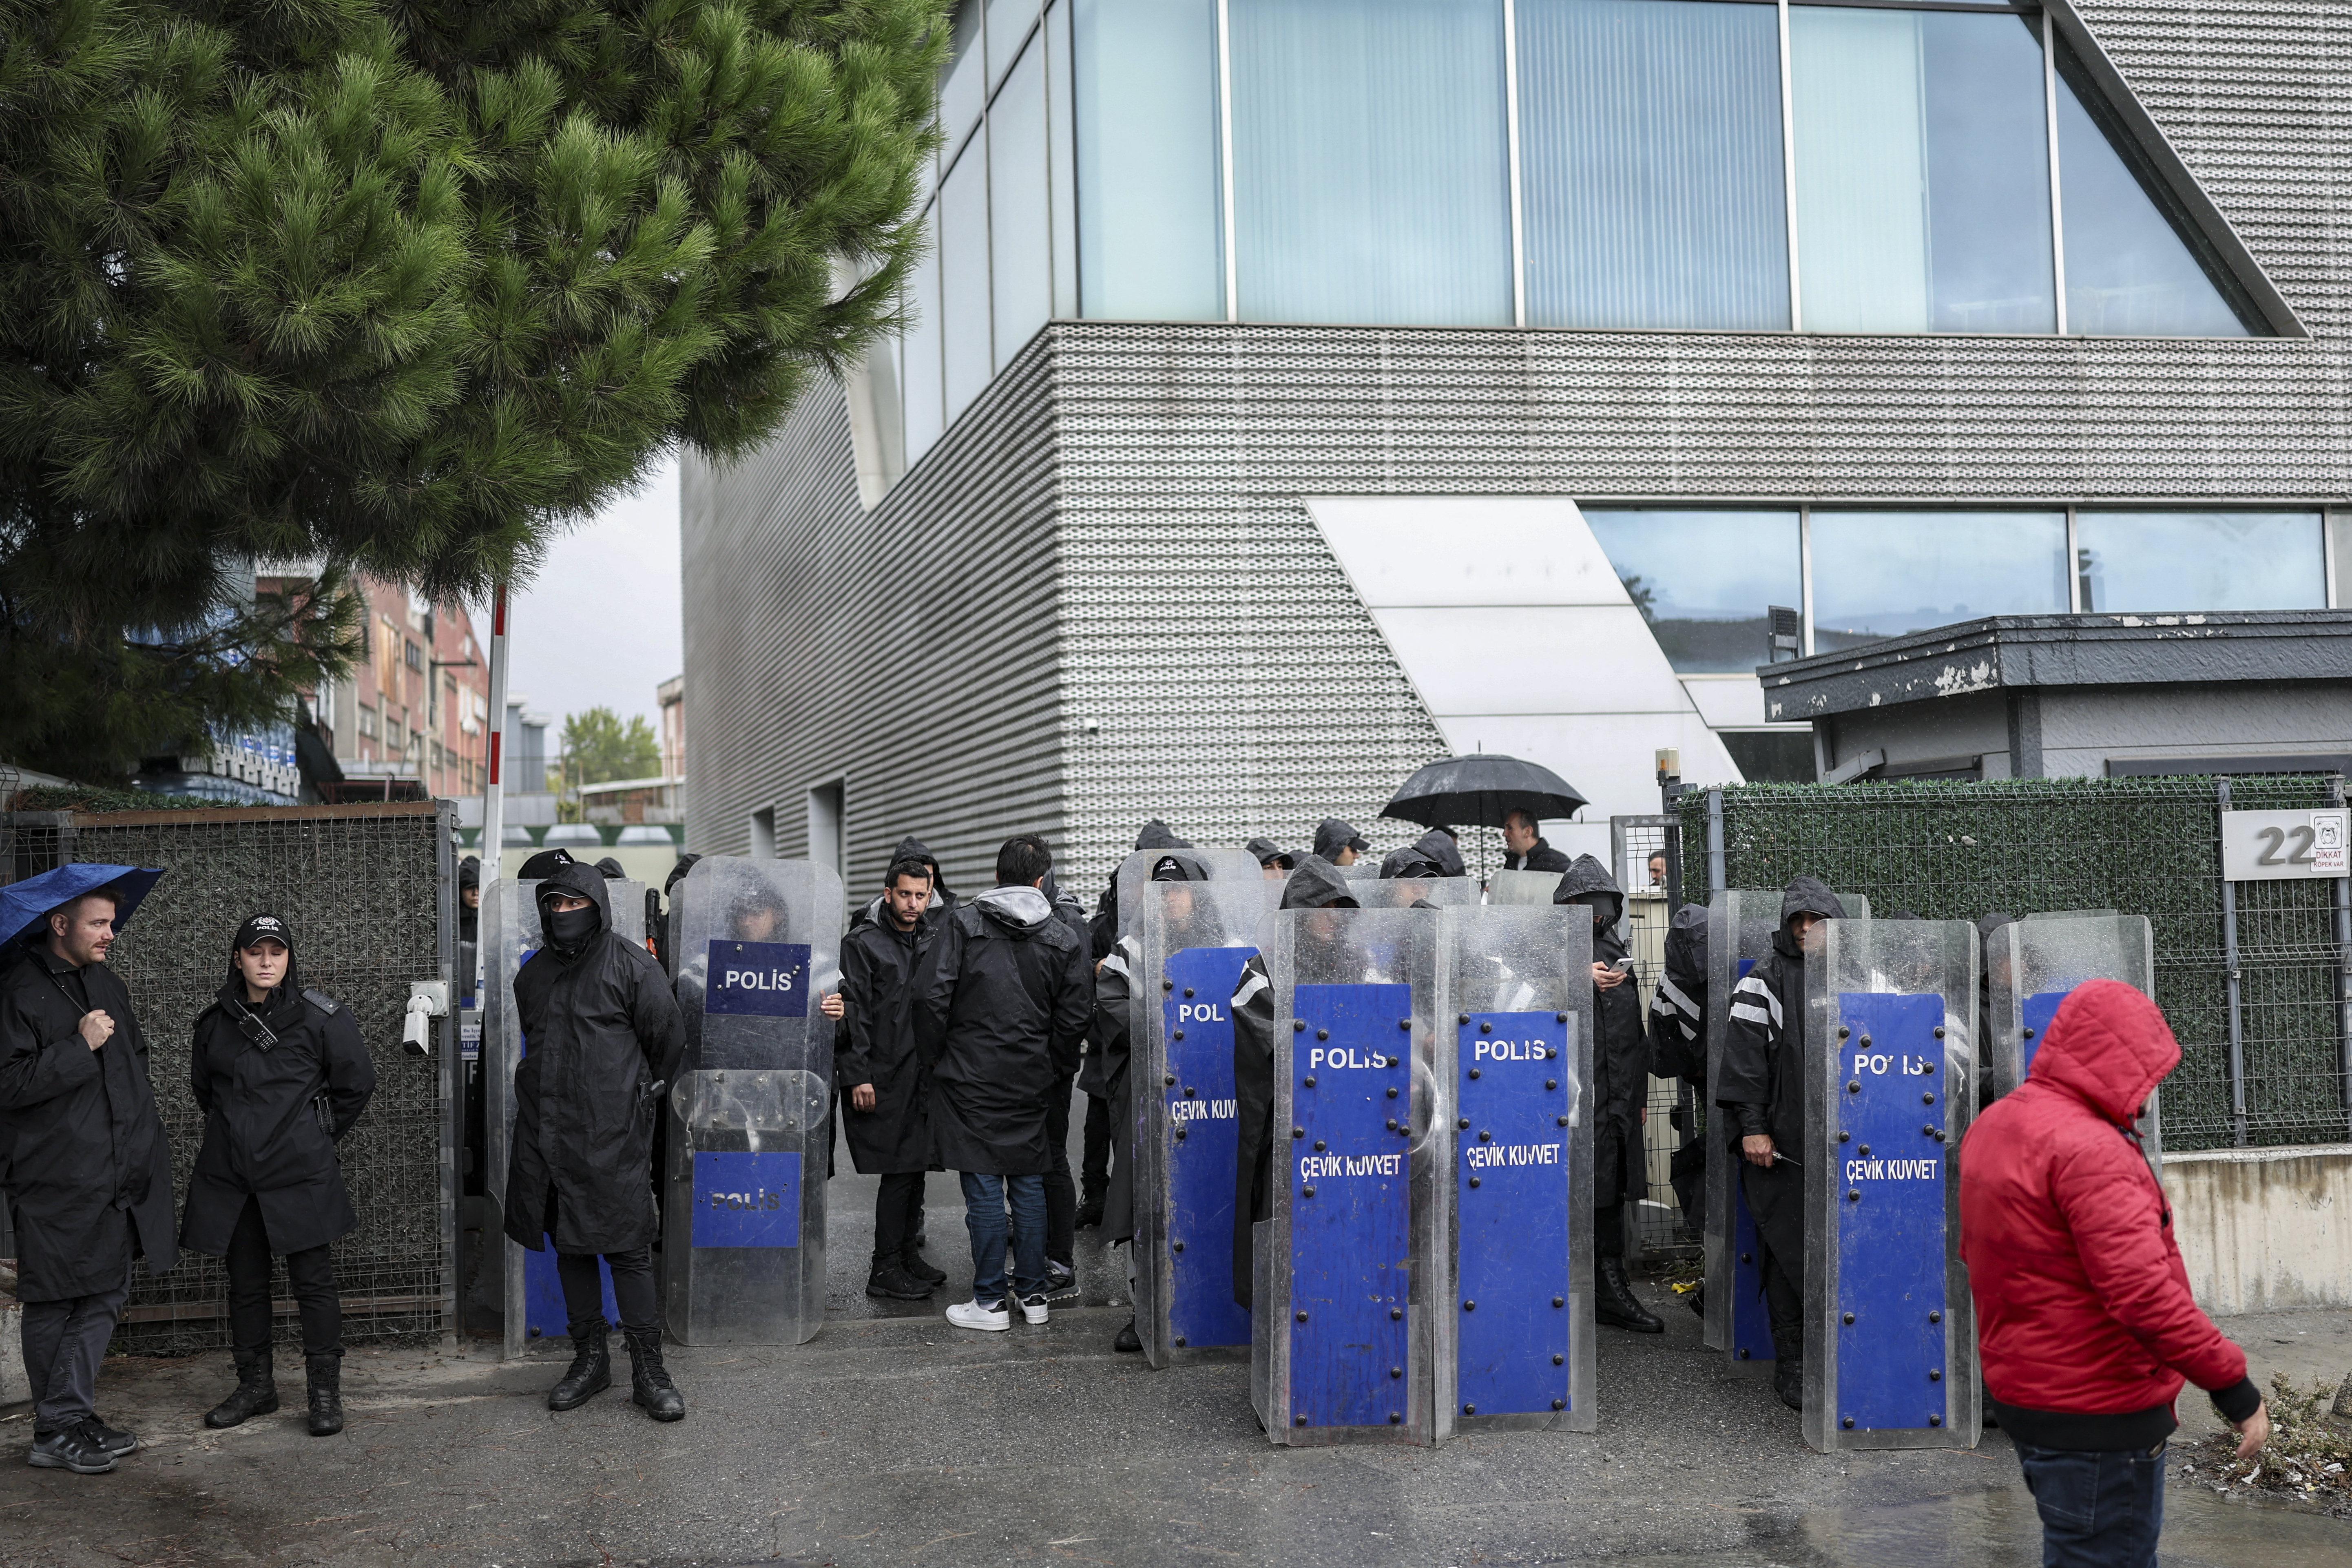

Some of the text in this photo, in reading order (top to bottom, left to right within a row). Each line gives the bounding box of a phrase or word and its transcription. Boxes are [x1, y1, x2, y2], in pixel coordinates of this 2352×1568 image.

[2261, 825, 2317, 865] 22
[2316, 850, 2342, 859] DİKKAT
[726, 969, 792, 991] POLİS
[1179, 1004, 1225, 1022] POL
[1854, 1055, 1924, 1075] POIS
[1301, 1151, 1342, 1182] ÇEVİK
[1467, 1141, 1506, 1171] ÇEVİK
[1846, 1155, 1937, 1185] ÇEVİK KUVVET
[712, 1188, 780, 1210] POLİS
